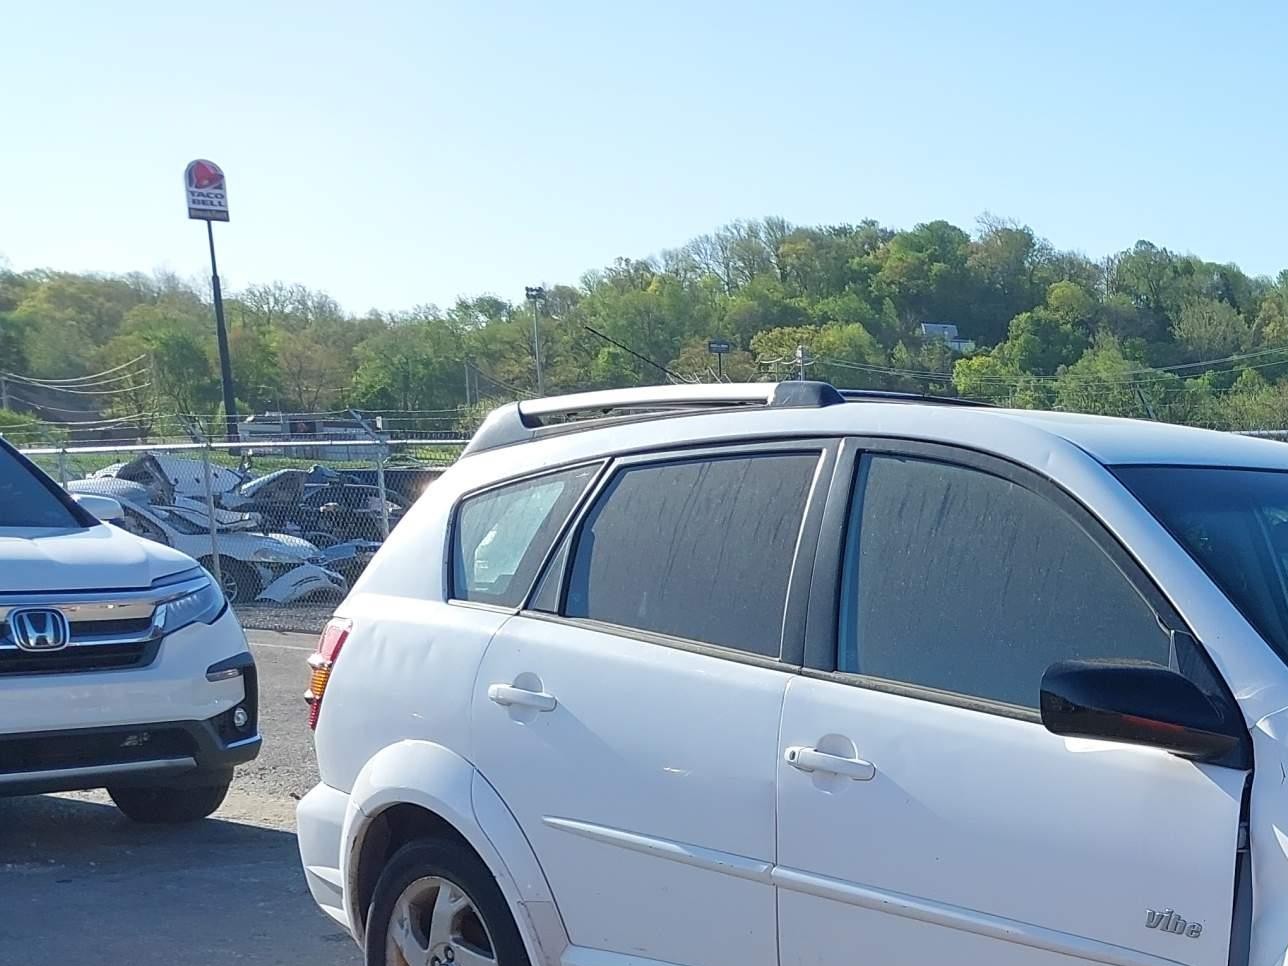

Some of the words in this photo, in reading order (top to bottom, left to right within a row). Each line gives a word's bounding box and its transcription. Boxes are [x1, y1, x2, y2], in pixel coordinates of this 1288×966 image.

[190, 191, 225, 199] TACO
[191, 199, 225, 207] BELL
[1145, 908, 1203, 938] vibe
